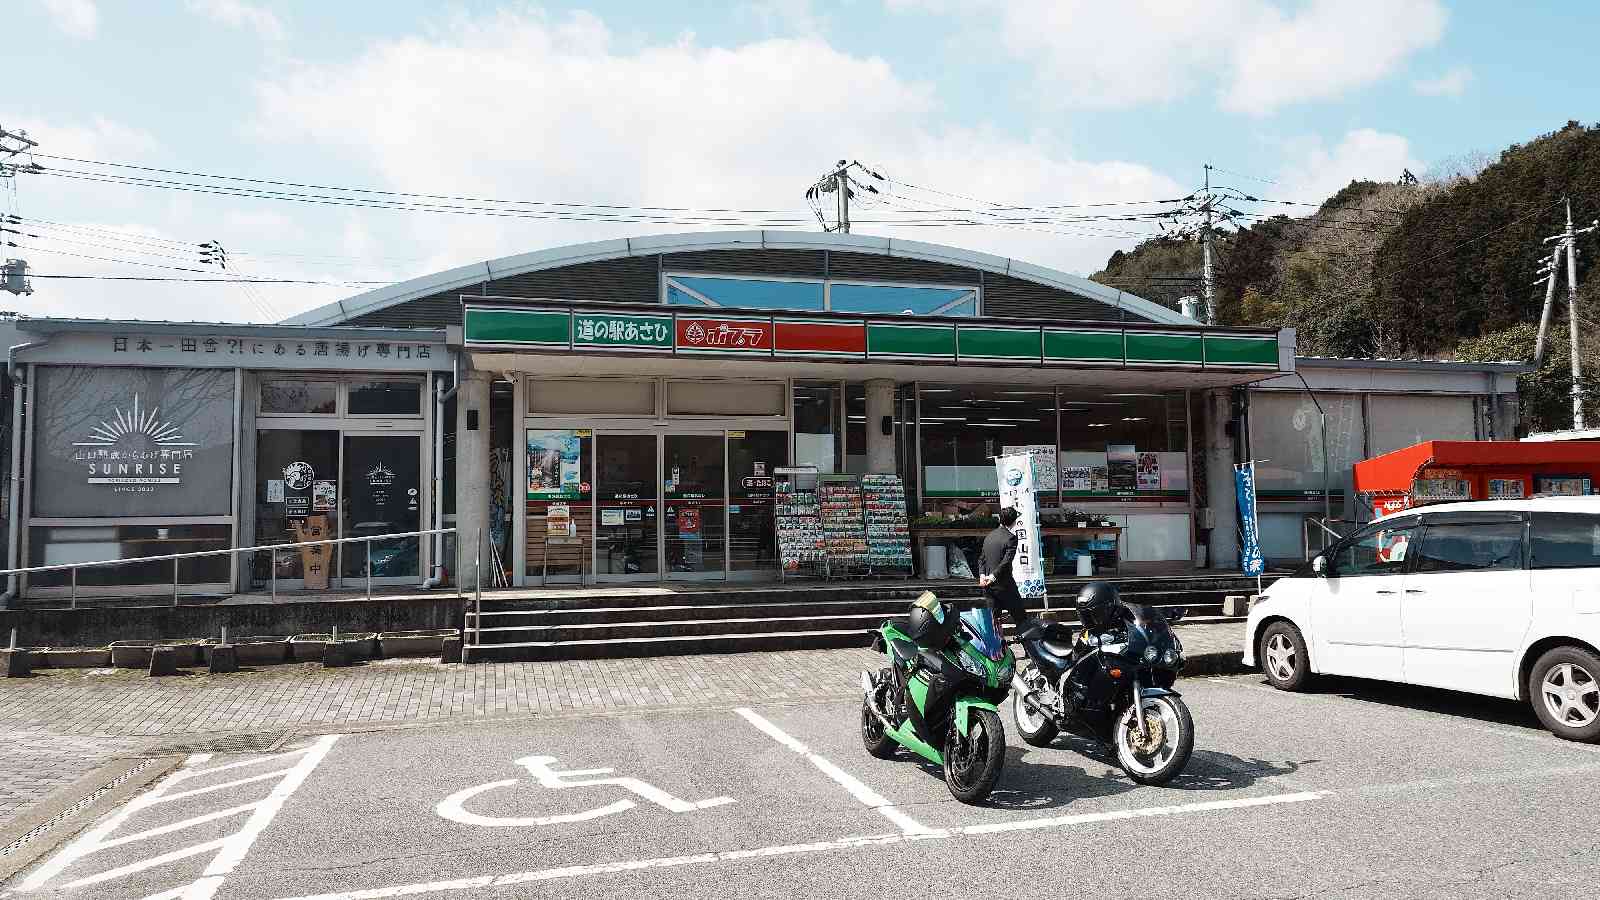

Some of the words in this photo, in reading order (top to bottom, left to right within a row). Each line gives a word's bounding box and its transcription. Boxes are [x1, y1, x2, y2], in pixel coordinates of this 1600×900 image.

[577, 318, 668, 342] 道の駅あさひ
[706, 323, 764, 346] ポプラ
[88, 463, 182, 475] SUNRISE
